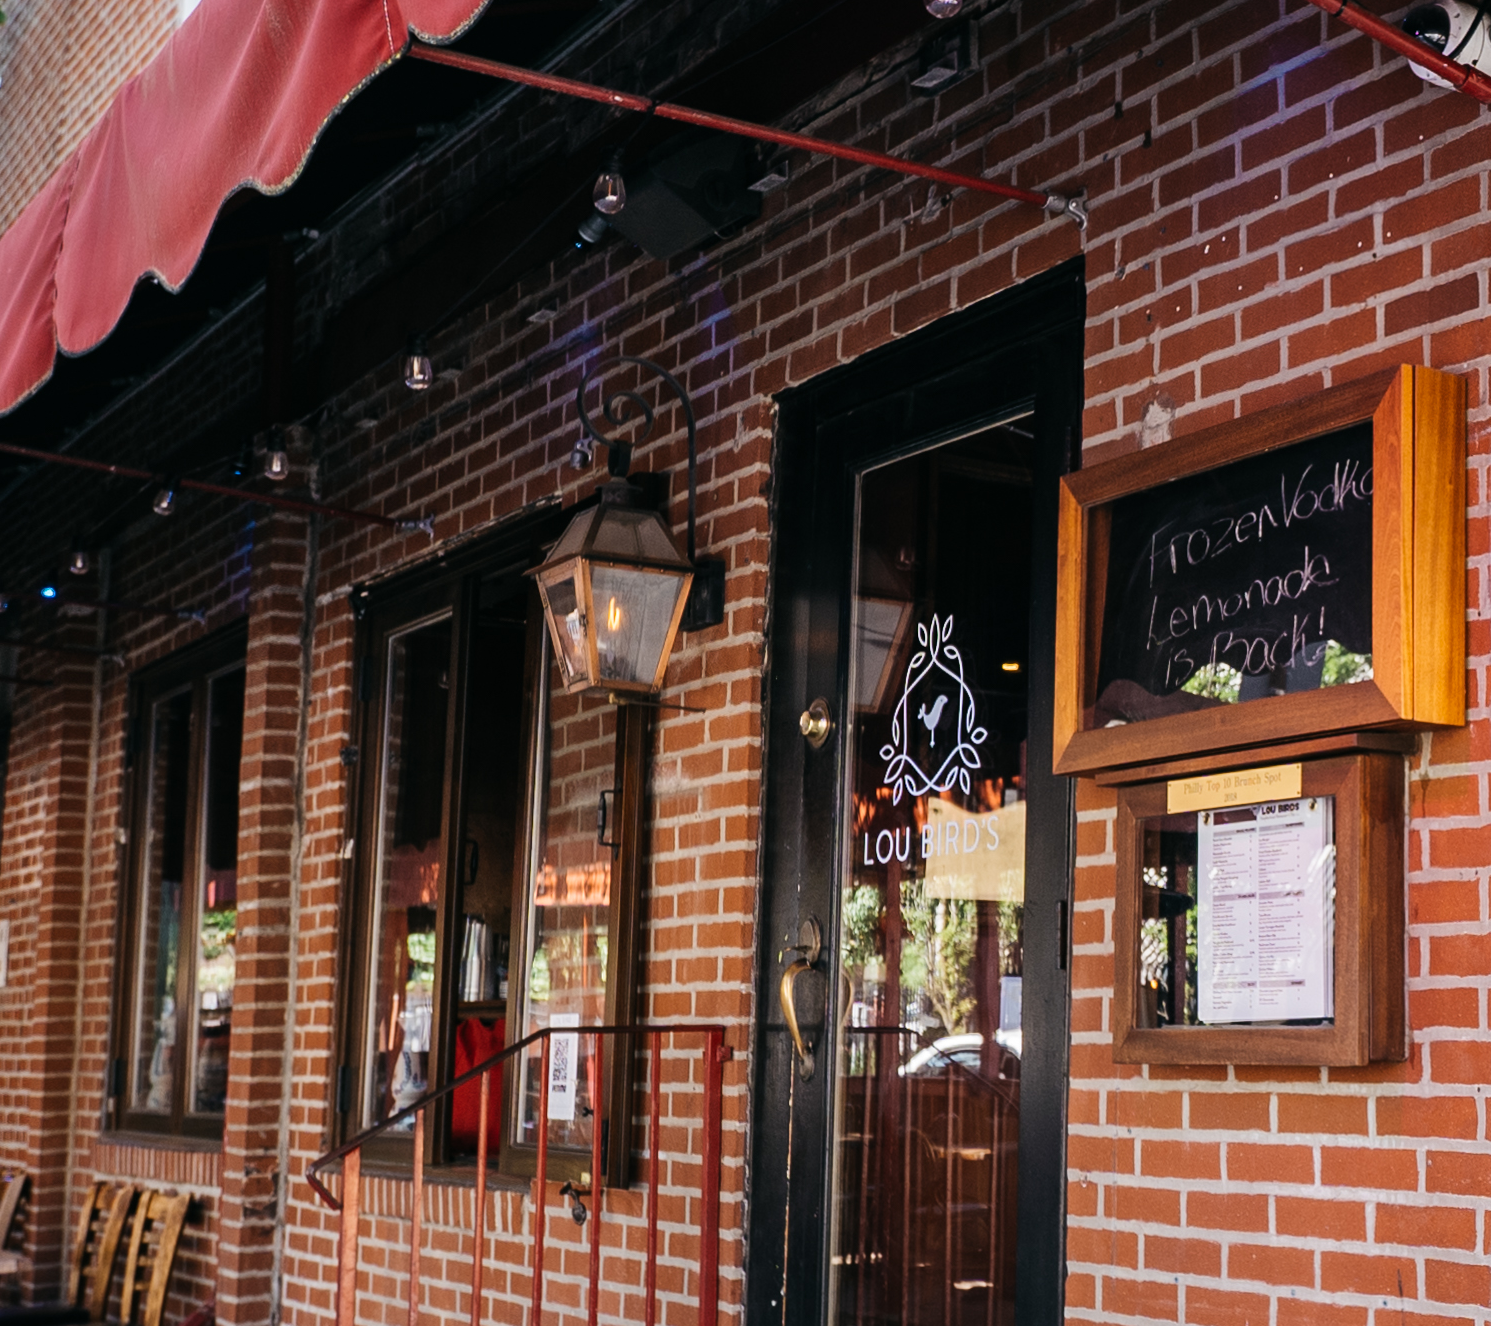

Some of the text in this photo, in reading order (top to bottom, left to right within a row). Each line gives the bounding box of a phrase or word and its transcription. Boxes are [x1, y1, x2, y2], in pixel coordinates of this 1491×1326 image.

[1149, 504, 1278, 589] Frozen
[1146, 545, 1340, 651] Lemonade
[1164, 605, 1329, 691] is Back!
[1183, 772, 1281, 795] Philly Top 10 Brunch Spot
[863, 814, 1000, 866] LOU BIRD'S
